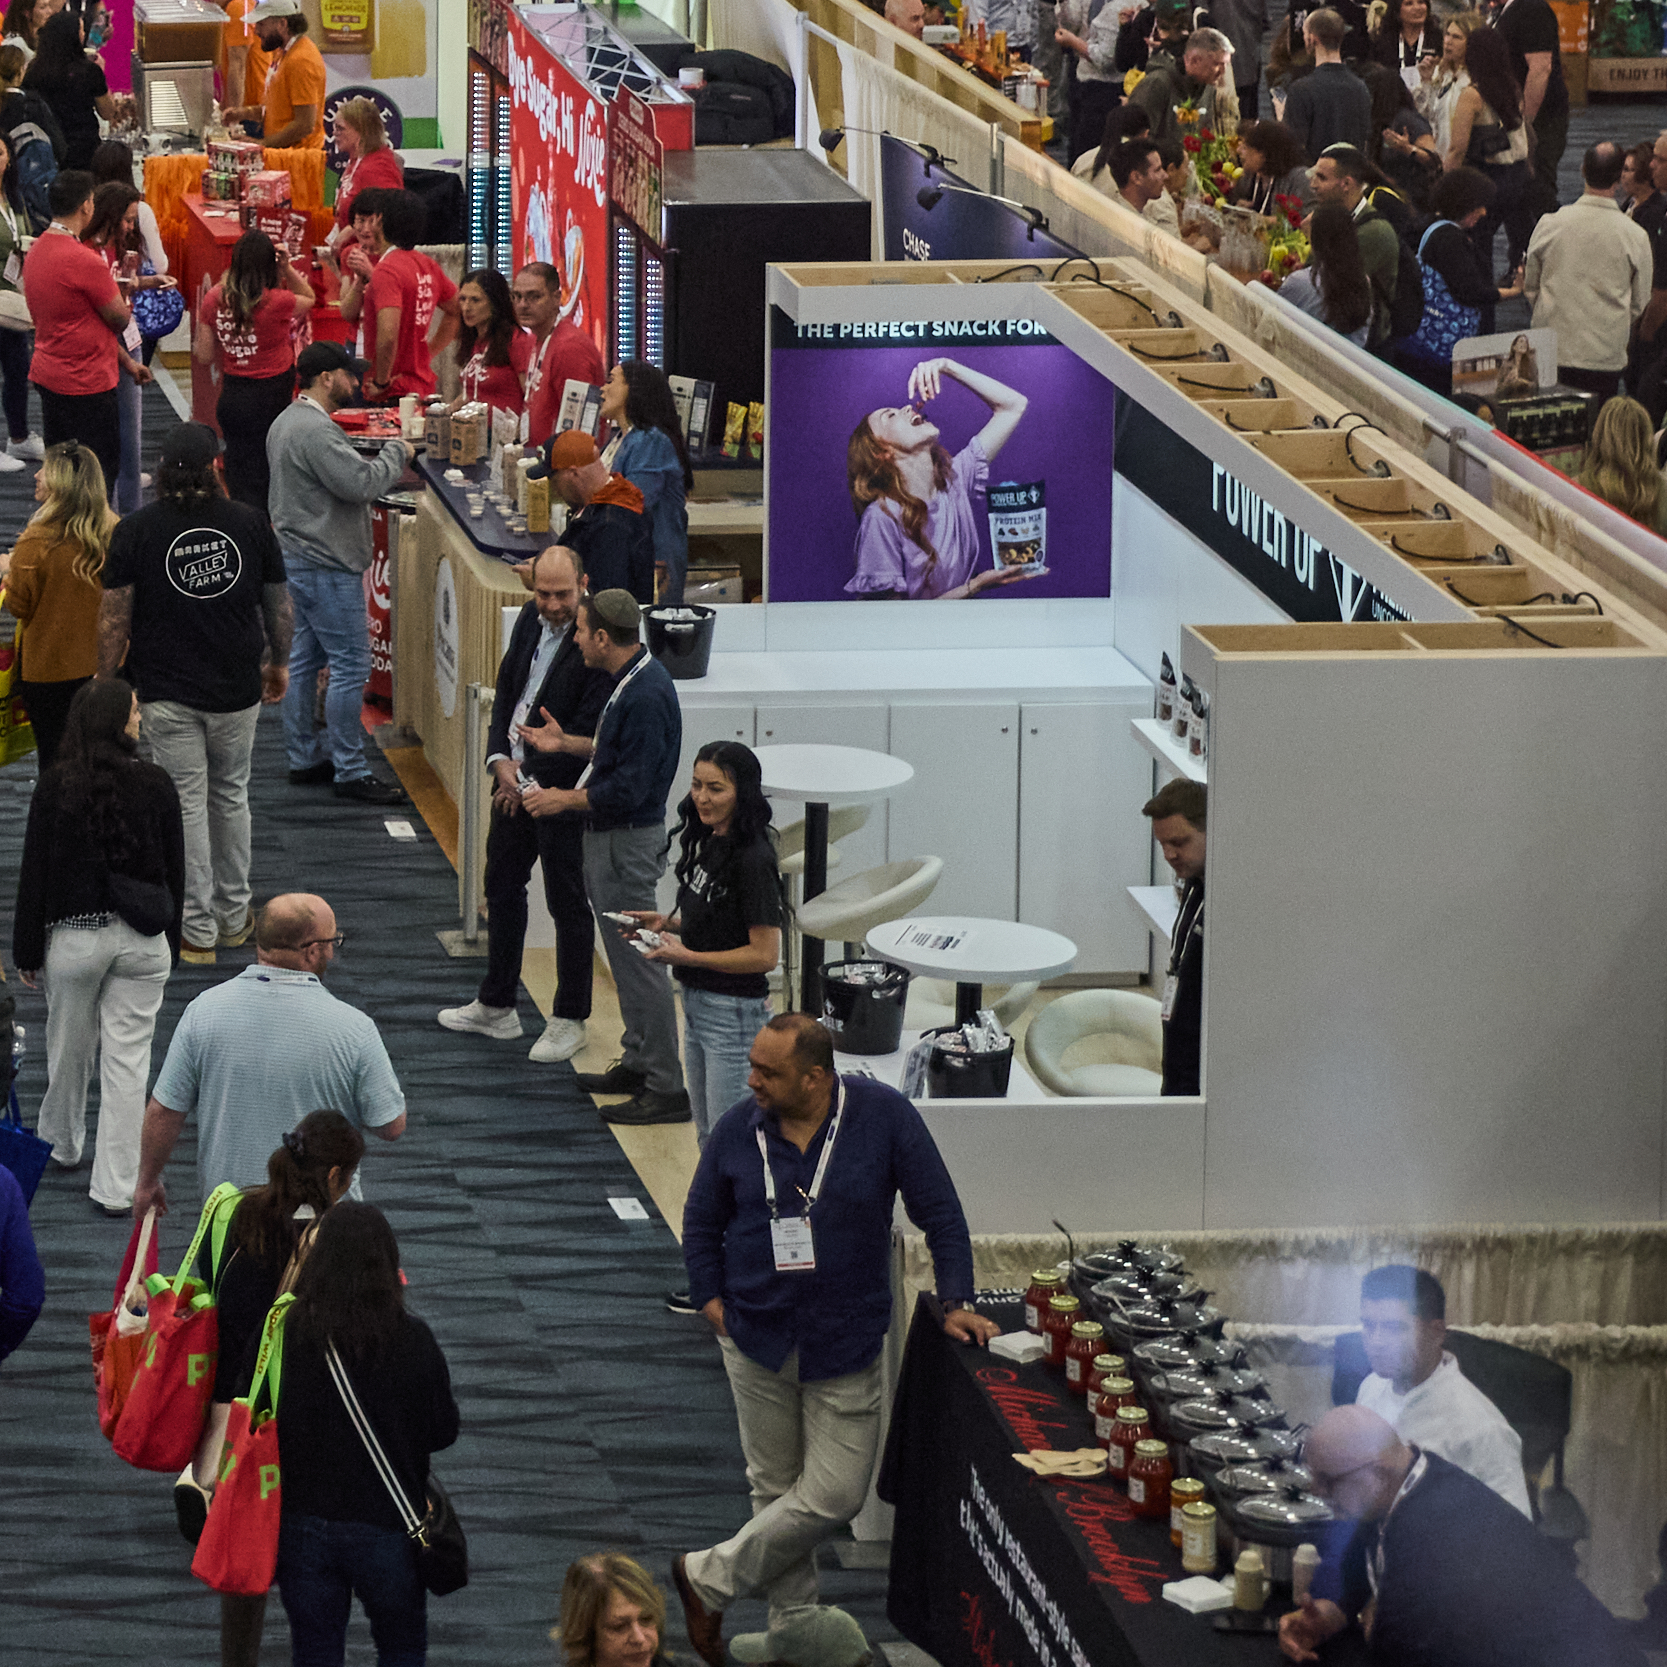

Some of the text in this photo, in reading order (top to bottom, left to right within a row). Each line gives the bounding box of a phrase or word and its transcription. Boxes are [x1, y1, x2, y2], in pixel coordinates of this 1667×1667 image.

[1609, 68, 1648, 82] ENJOY
[561, 91, 574, 157] Hi
[902, 227, 932, 263] CHASE
[795, 318, 1001, 338] THE PERFECT SNACK
[990, 491, 1028, 507] POWER UP
[995, 513, 1043, 525] PROTEIN MIX
[1211, 460, 1288, 570] POWER
[173, 538, 228, 557] MARKET
[178, 550, 229, 582] VALLEY
[187, 573, 222, 591] FARM
